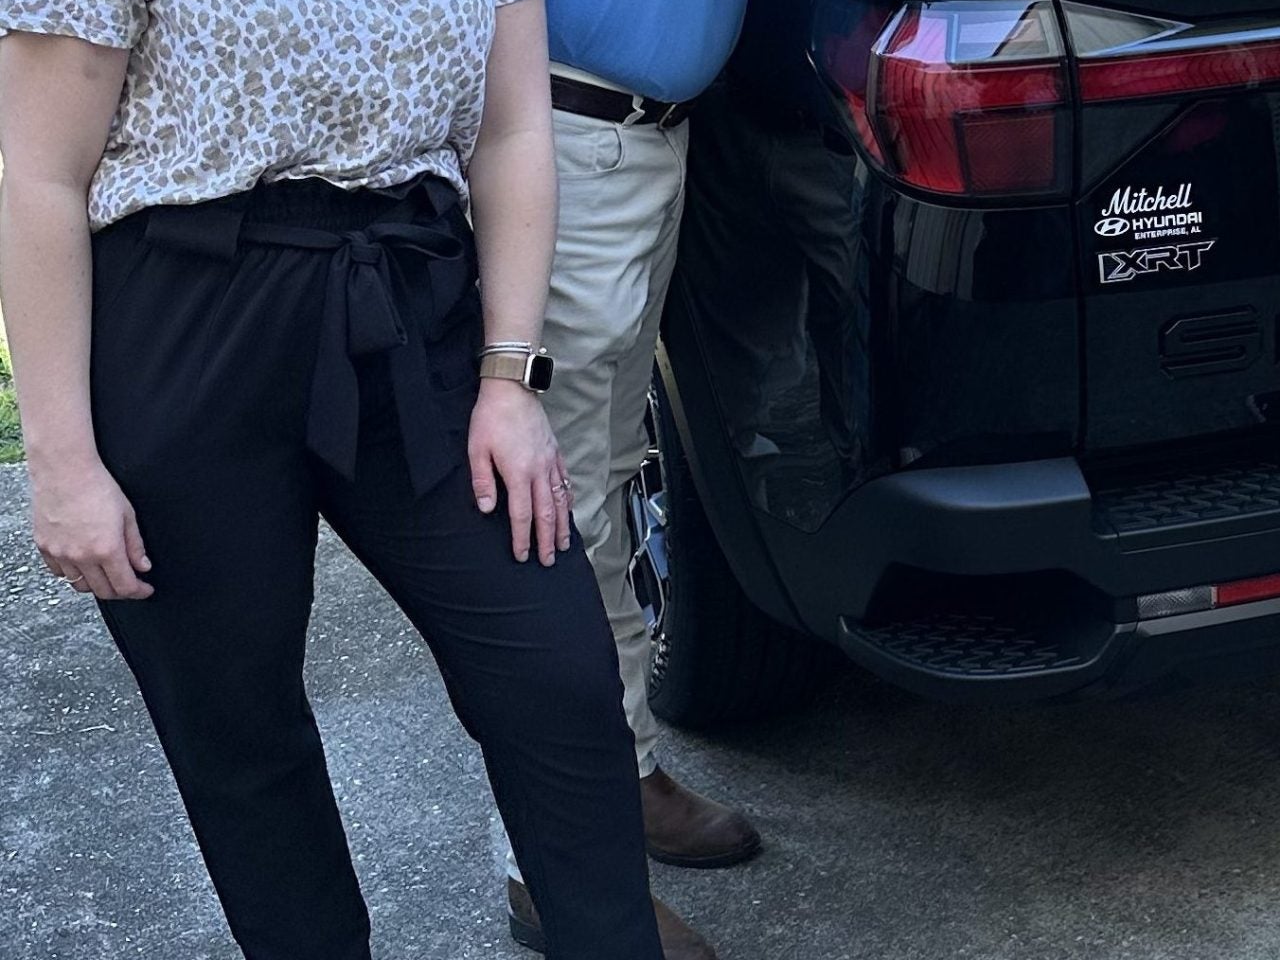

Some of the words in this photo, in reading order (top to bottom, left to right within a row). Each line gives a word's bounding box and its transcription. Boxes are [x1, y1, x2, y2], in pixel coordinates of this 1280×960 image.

[1101, 183, 1192, 217] Mitchell
[1132, 212, 1203, 230] HYUNDAI
[1134, 227, 1189, 240] ENTERPRISE,
[1191, 226, 1202, 234] AL
[1098, 240, 1216, 284] XRT
